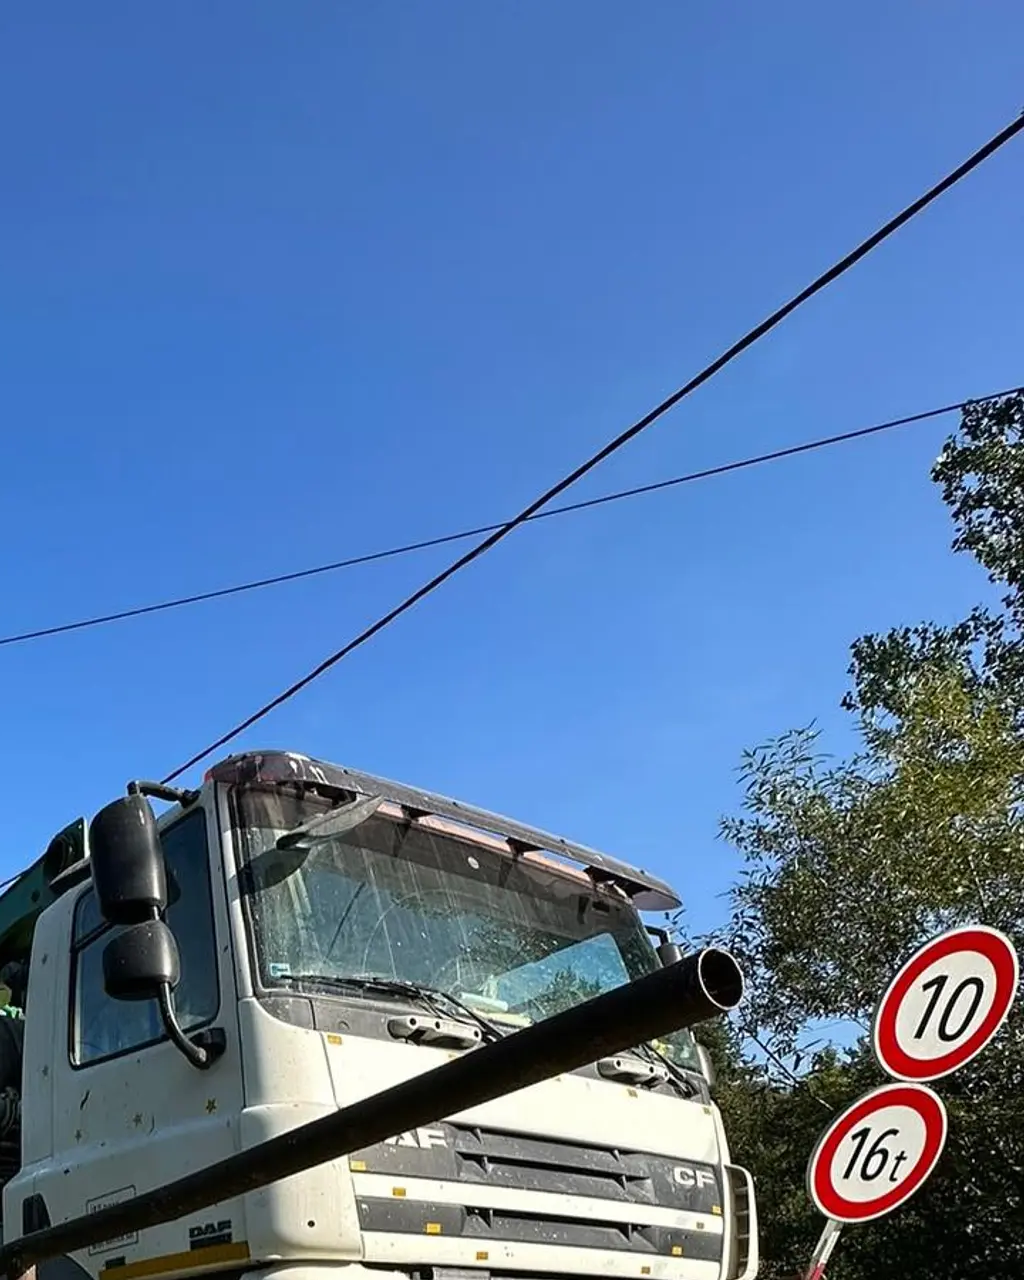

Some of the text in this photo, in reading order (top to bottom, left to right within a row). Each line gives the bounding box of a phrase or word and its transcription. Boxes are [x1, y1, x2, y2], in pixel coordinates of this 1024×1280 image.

[914, 975, 984, 1042] 10
[384, 1127, 448, 1149] AF
[673, 1166, 715, 1188] CF
[189, 1219, 232, 1238] DAF
